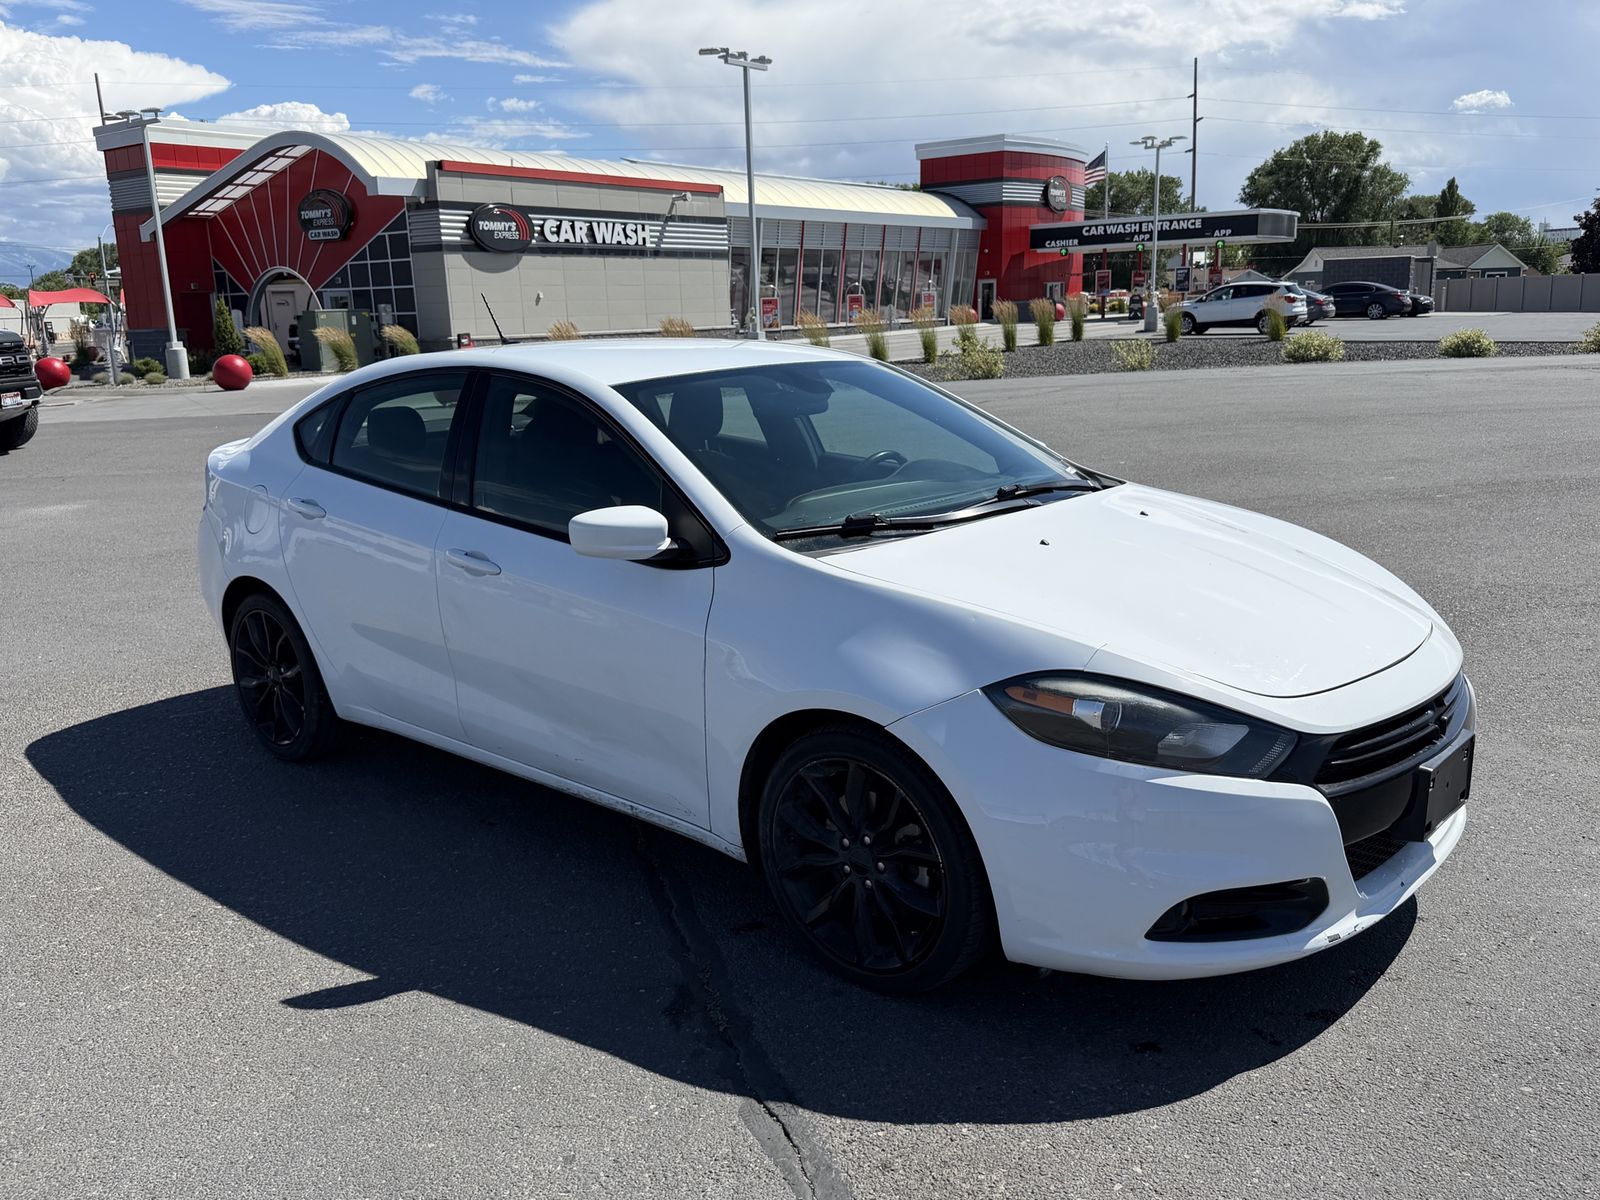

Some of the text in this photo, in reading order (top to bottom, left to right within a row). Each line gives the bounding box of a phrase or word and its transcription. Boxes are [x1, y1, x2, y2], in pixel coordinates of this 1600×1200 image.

[301, 209, 331, 219] TOMMY'S
[313, 218, 334, 226] EXPRESS
[478, 221, 516, 231] TOMMY'S
[543, 219, 650, 246] CAR WASH
[1082, 226, 1105, 236] CAR
[1106, 223, 1140, 235] WASH
[1213, 229, 1232, 237] APP
[494, 231, 520, 240] EXPRESS
[1133, 234, 1151, 242] APP
[1045, 239, 1079, 248] CASHIER
